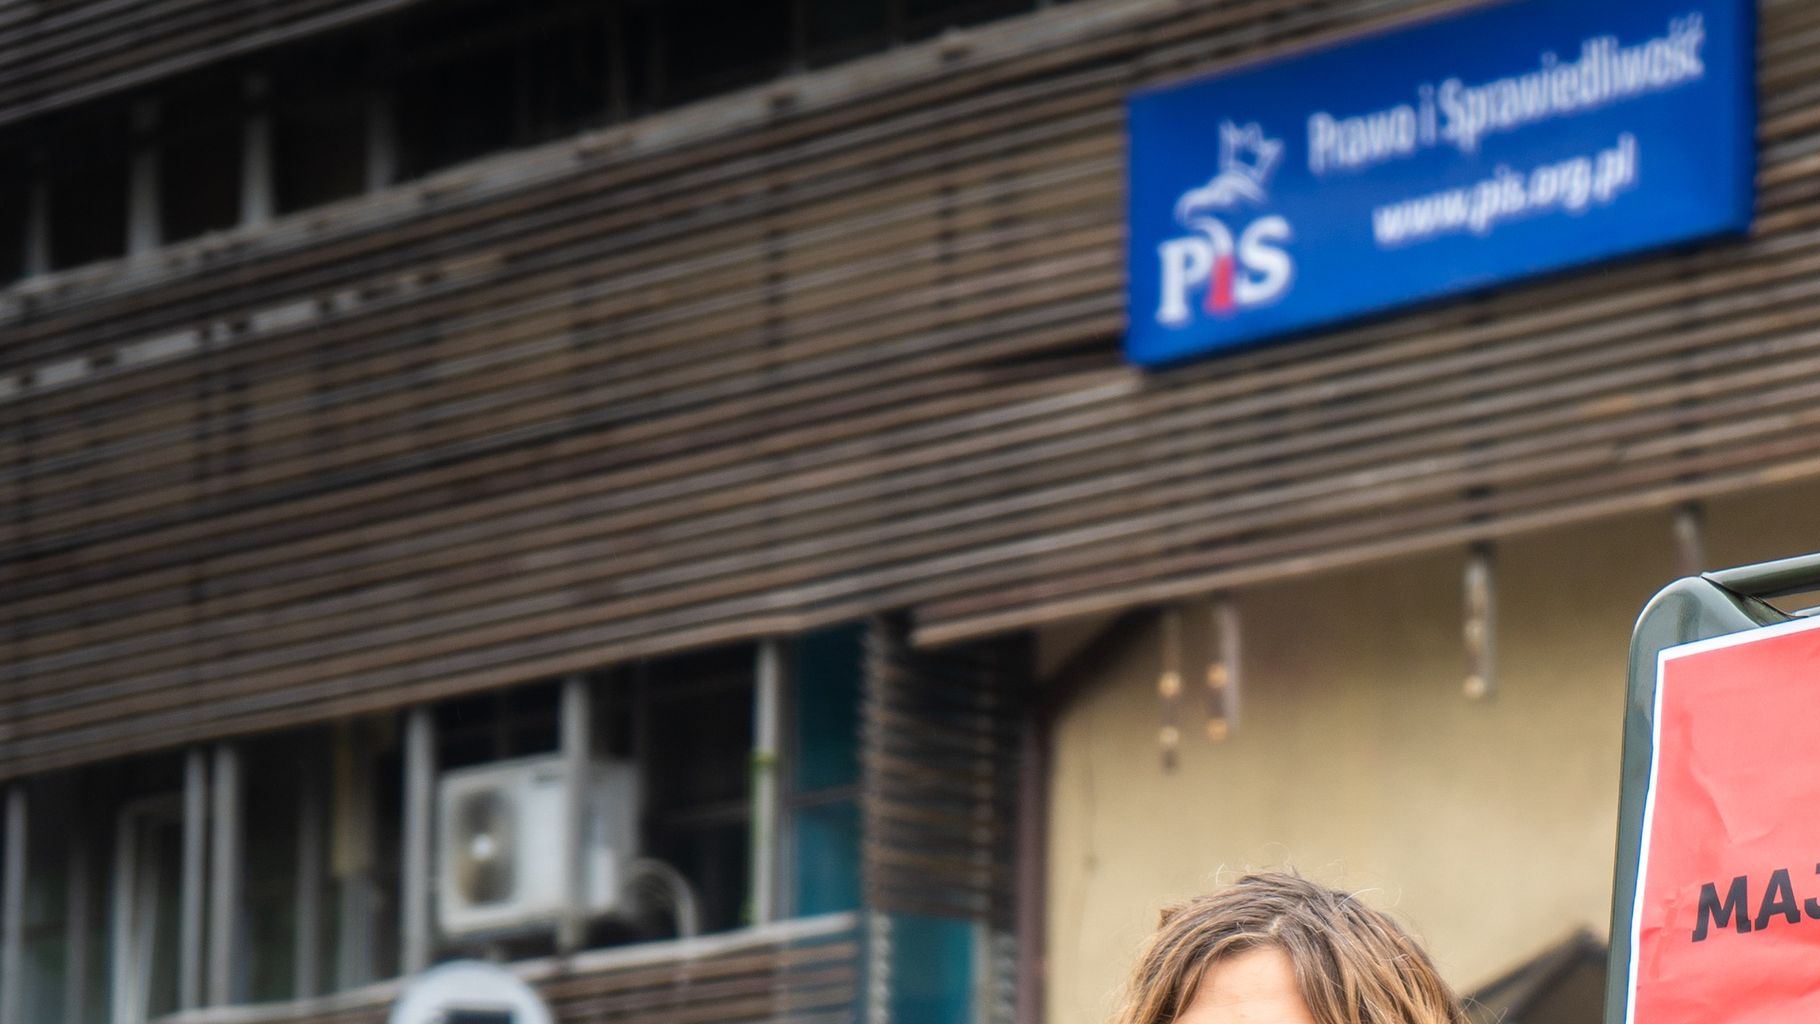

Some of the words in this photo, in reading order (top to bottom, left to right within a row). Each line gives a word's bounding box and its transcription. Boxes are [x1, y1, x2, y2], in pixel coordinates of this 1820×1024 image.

[1308, 111, 1416, 175] Prawo
[1418, 83, 1436, 146] i
[1439, 12, 1704, 151] Sprawiedliwość
[1373, 131, 1638, 246] www.pis.org.pl
[1156, 215, 1293, 327] PiS
